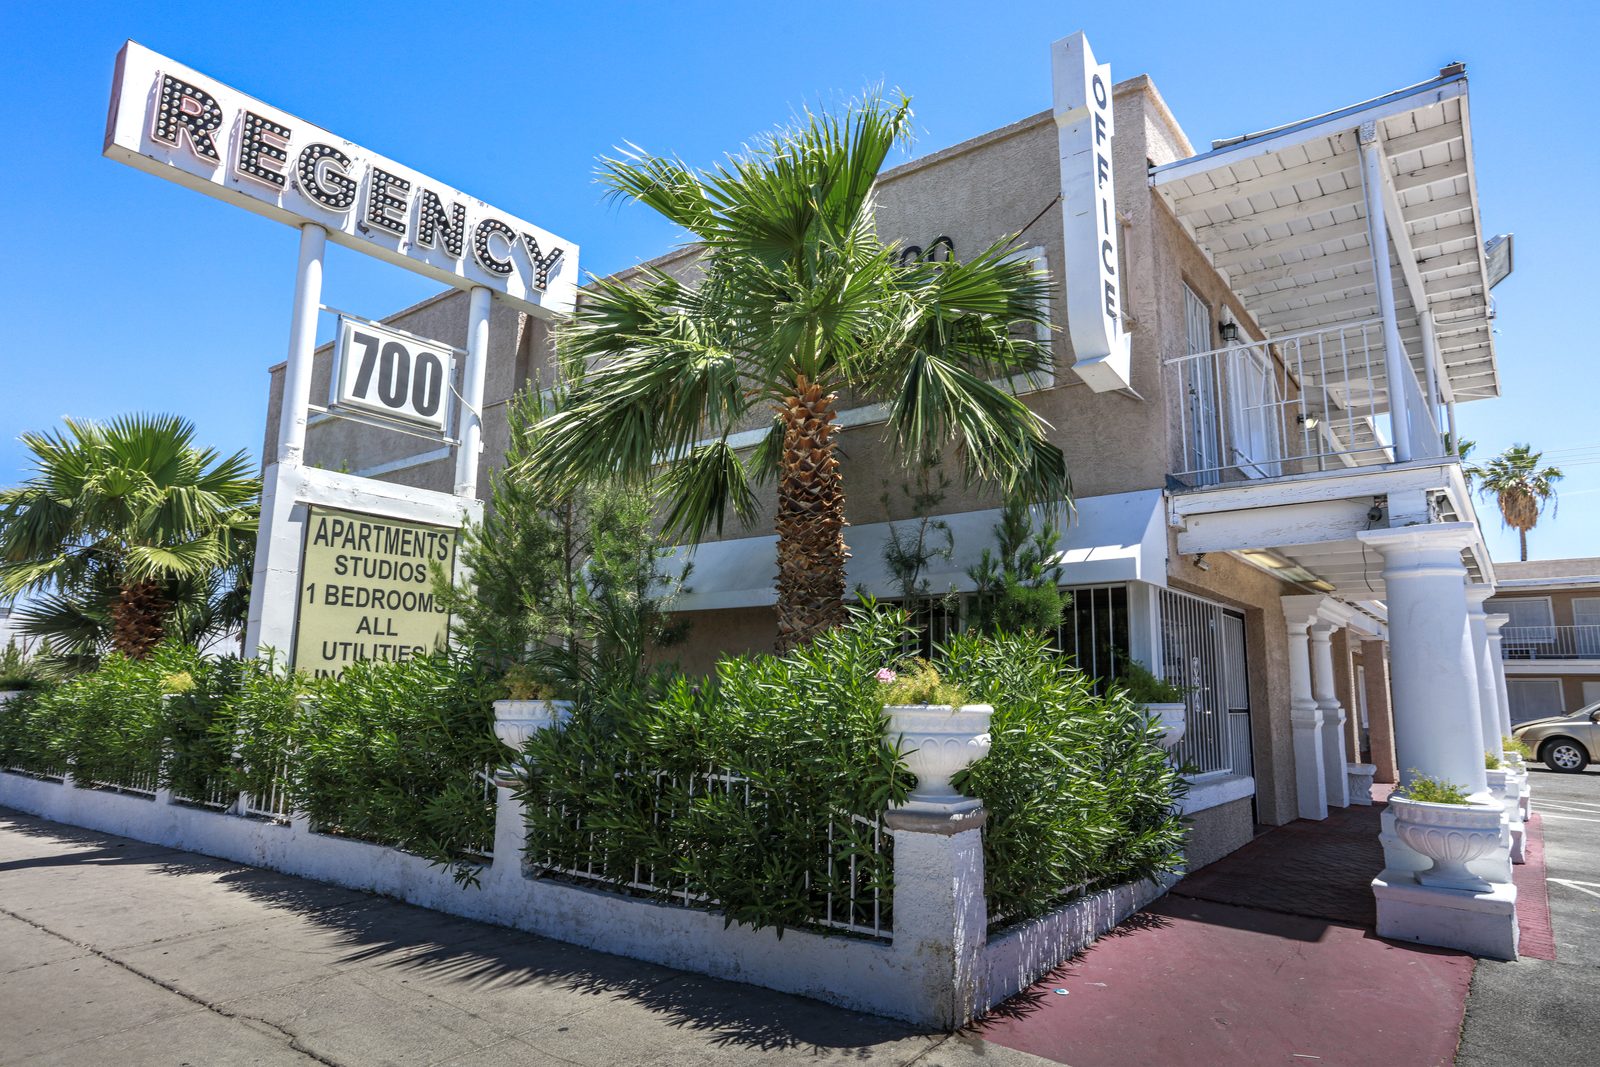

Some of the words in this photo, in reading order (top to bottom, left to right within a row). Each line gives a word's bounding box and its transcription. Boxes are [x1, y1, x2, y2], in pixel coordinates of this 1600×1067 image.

[151, 71, 565, 292] REGENCY
[1092, 74, 1116, 318] OFFICE
[352, 332, 443, 417] 700
[313, 518, 449, 561] APARTMENTS
[334, 554, 427, 583] STUDIOS
[306, 583, 315, 604] 1
[356, 616, 398, 636] ALL
